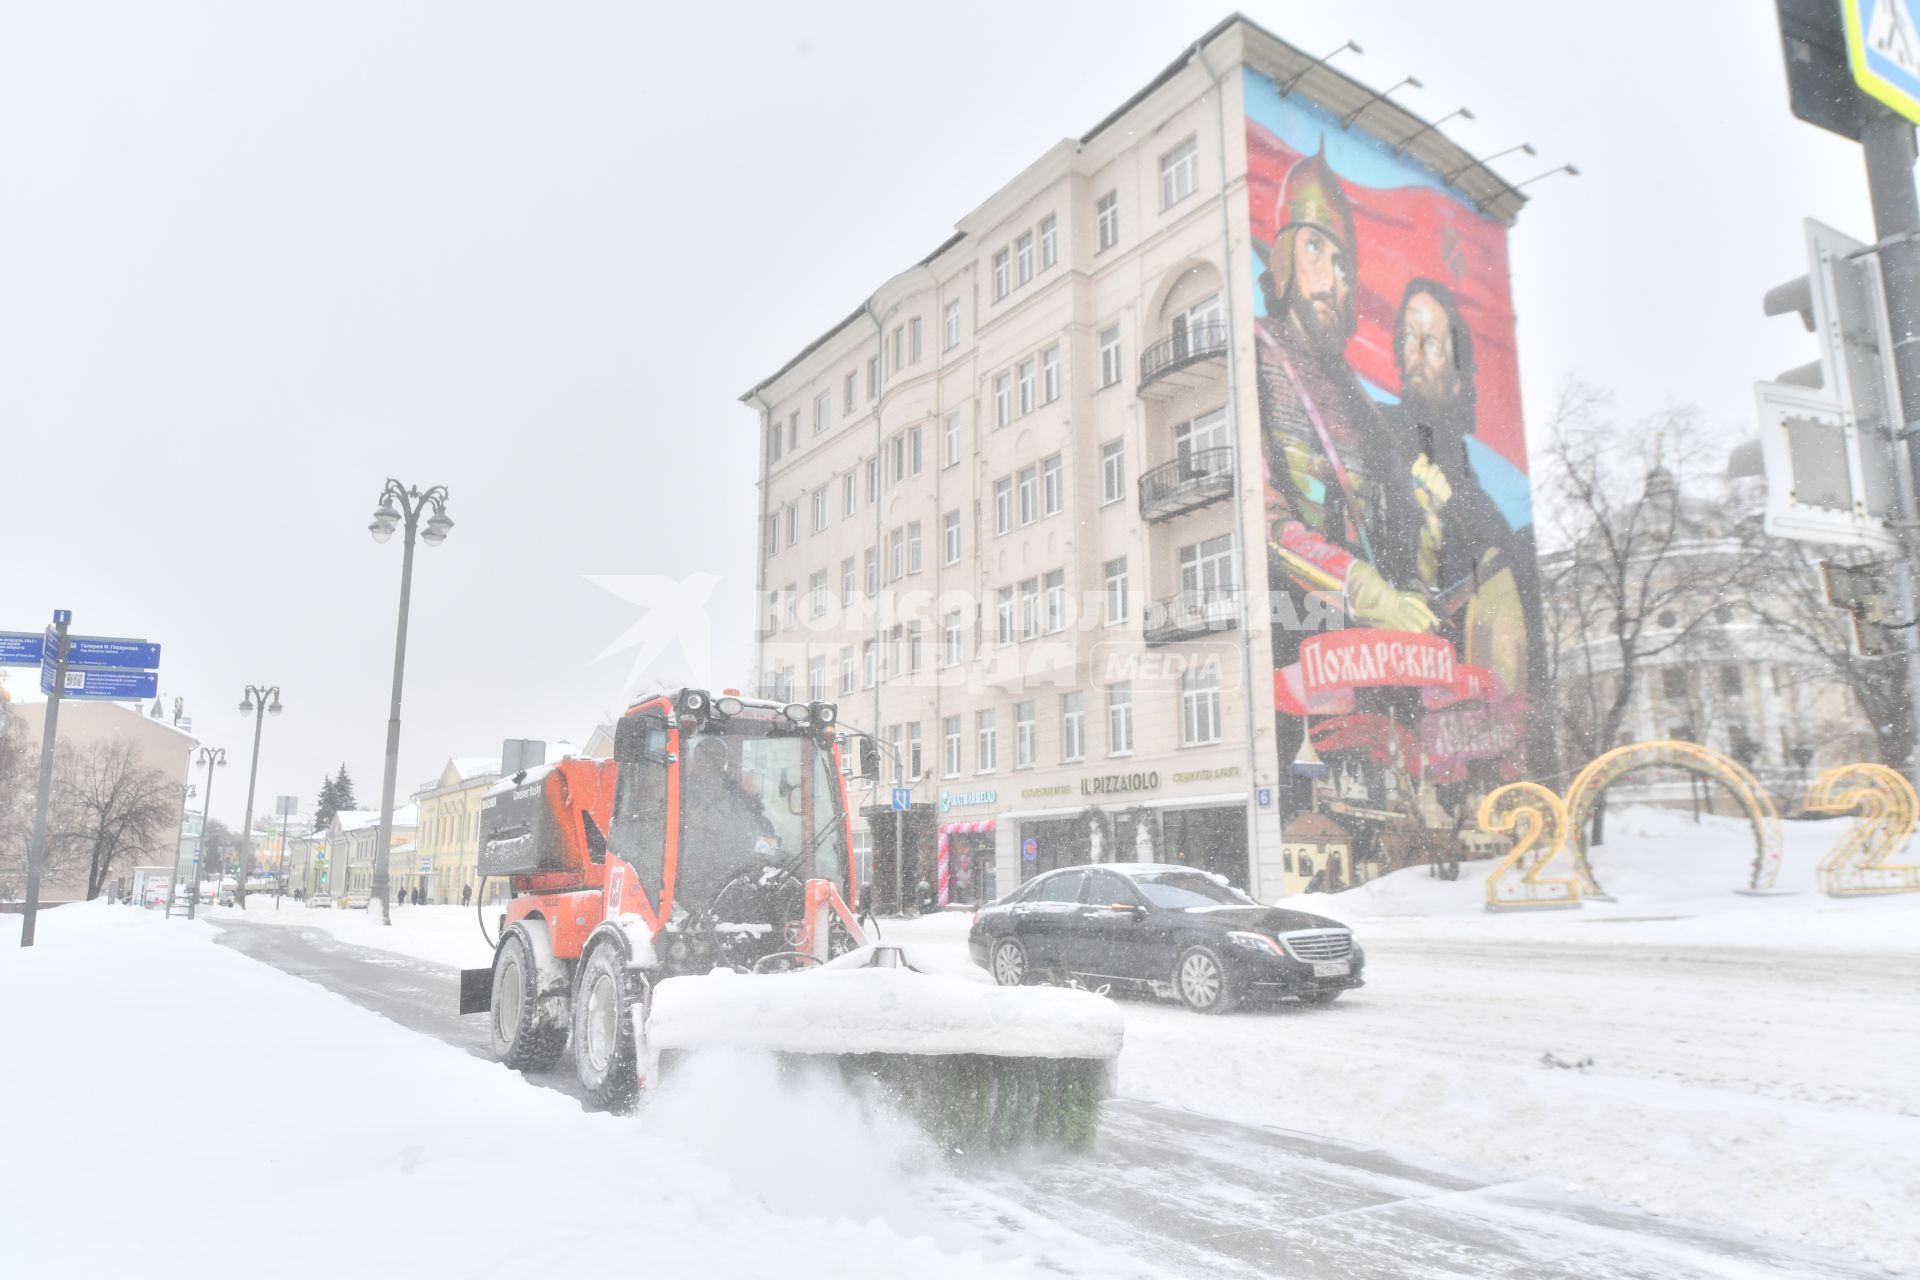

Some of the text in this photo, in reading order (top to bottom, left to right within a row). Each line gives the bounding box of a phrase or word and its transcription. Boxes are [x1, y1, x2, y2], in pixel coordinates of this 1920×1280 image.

[1080, 777, 1091, 796] IL
[1093, 771, 1159, 794] PIZZAIOLO
[1260, 791, 1269, 806] 6
